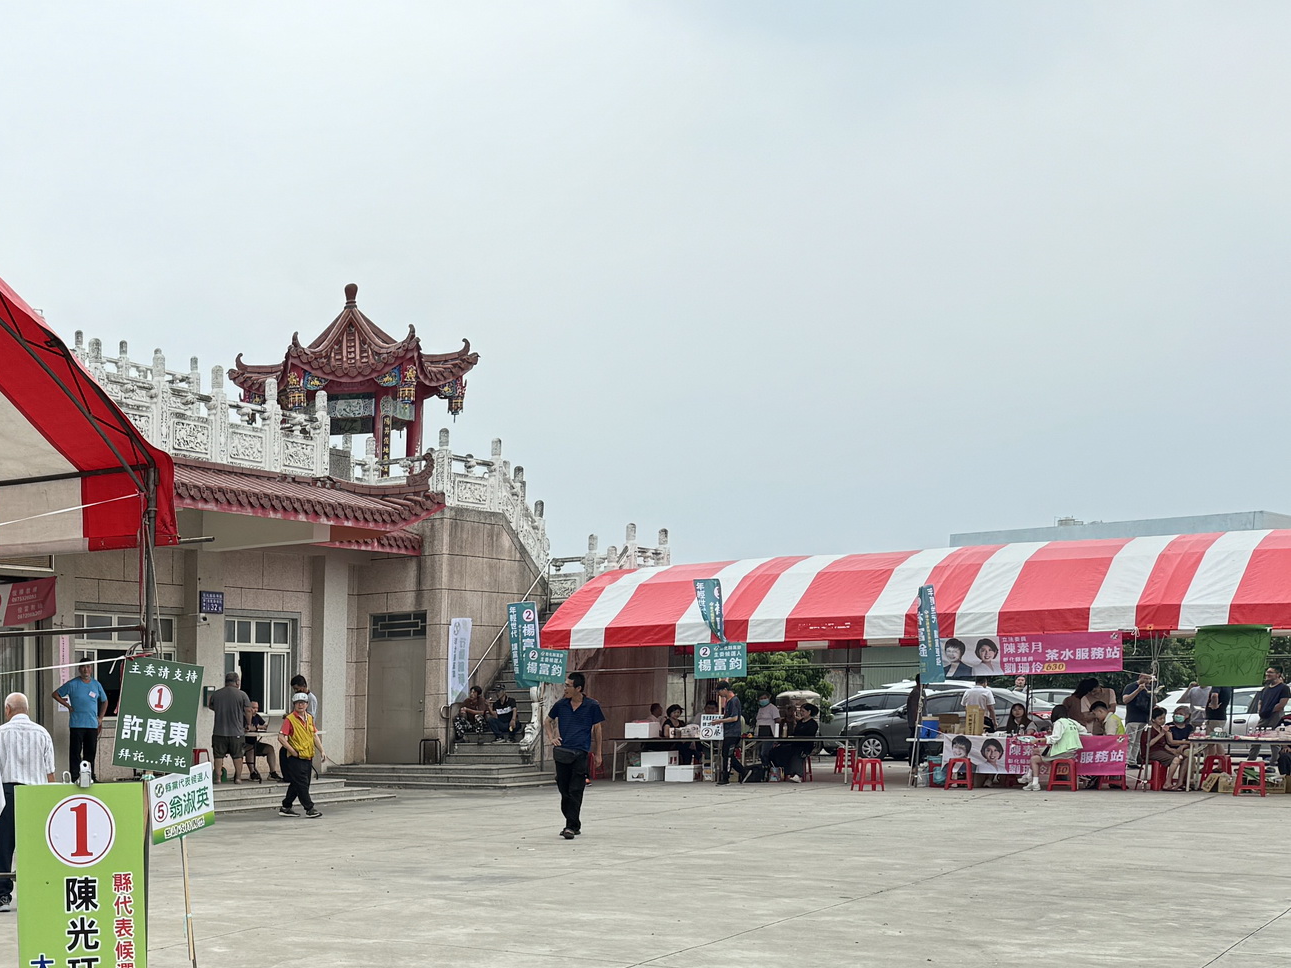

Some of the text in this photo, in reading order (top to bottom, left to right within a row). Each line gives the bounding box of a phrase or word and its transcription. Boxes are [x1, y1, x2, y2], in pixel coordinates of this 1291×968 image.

[1003, 641, 1043, 654] 陳素月
[1045, 646, 1121, 661] 茶水服務站
[129, 662, 198, 684] 主委請支持
[1004, 662, 1064, 674] 劉珊伶 630
[121, 714, 190, 748] 許廣東
[169, 786, 210, 820] 翁淑英
